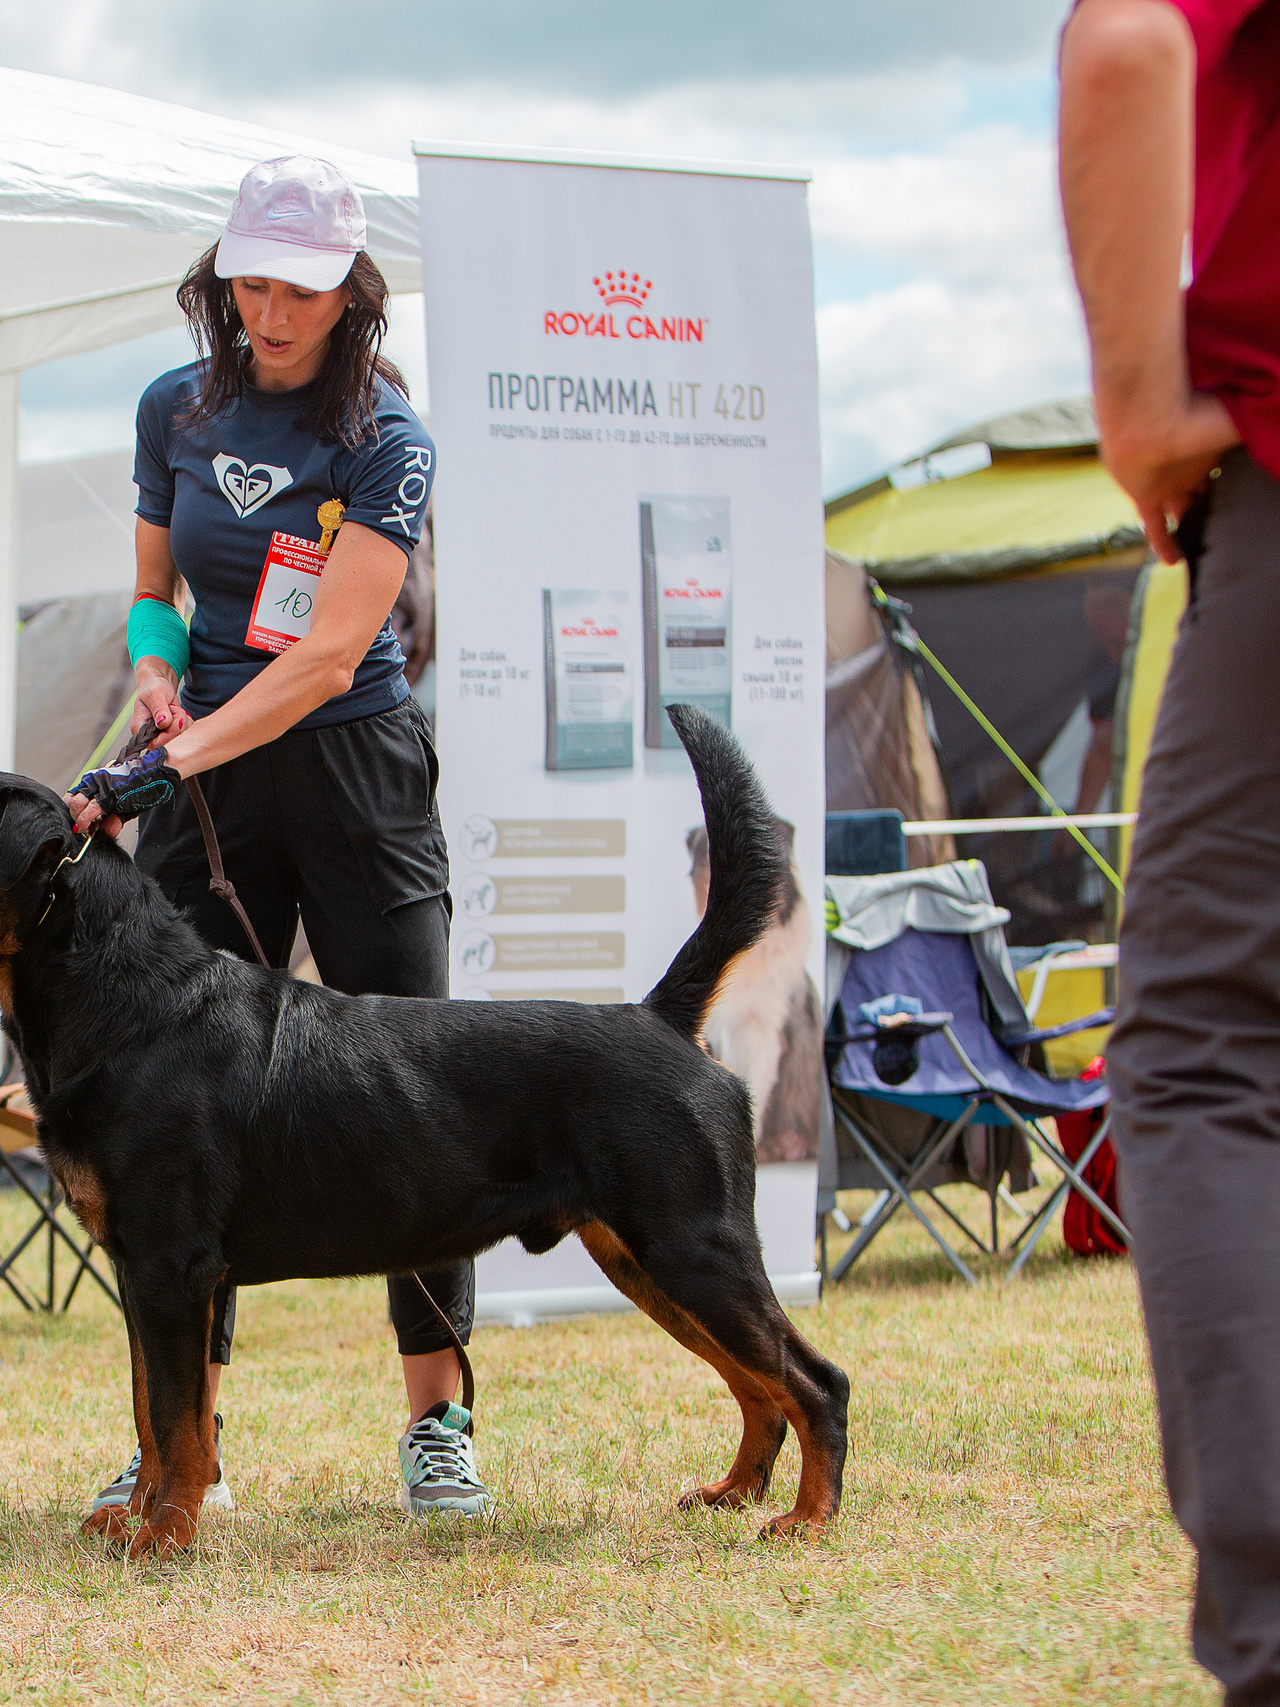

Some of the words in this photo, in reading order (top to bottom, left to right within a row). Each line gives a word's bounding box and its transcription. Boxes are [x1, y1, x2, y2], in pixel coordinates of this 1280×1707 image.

[544, 310, 621, 339] ROYAL
[626, 314, 704, 343] CANIN
[488, 371, 659, 417] ПРОГРАММА
[715, 384, 766, 421] 42D
[540, 425, 560, 440] ДЛЯ
[563, 427, 593, 441] СОБАК
[380, 446, 432, 537] ROX
[274, 587, 313, 619] 10
